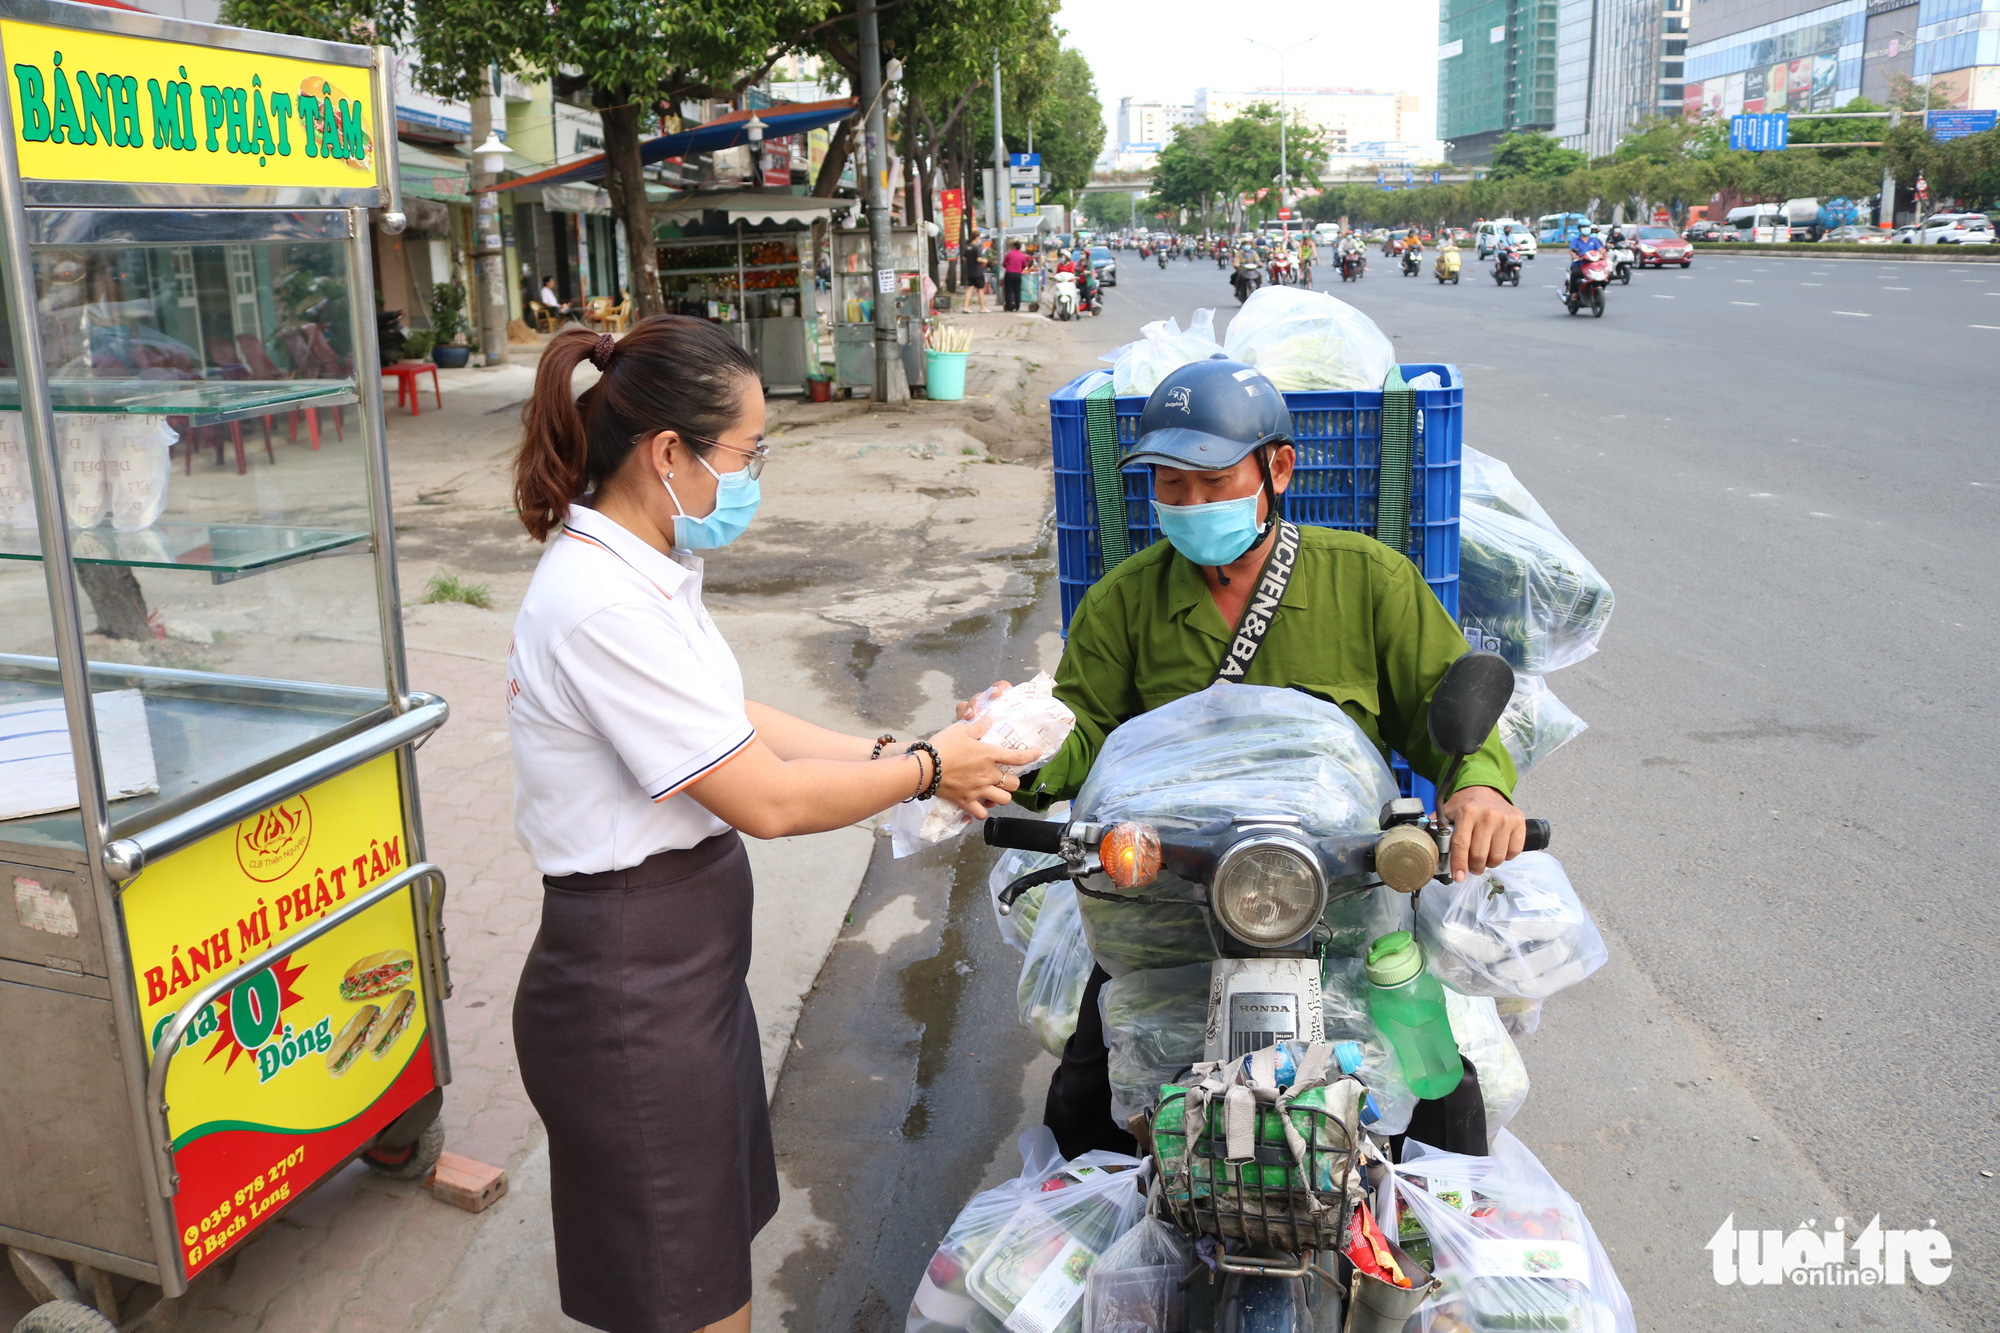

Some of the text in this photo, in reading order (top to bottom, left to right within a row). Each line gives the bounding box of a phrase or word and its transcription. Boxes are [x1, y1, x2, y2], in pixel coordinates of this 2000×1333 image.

[13, 50, 366, 167] BÁNH MÌ PHẬT TÂM
[1214, 518, 1299, 684] KUCHEN&BA
[249, 859, 263, 869] CLB
[143, 835, 401, 1007] BÁNH MÌ PHẬT TÂM
[230, 966, 281, 1050] 0
[258, 1015, 332, 1084] Đồng
[1239, 1005, 1290, 1013] HONDA
[200, 1145, 305, 1233] 038 878 2707
[204, 1180, 290, 1256] Bạch Long
